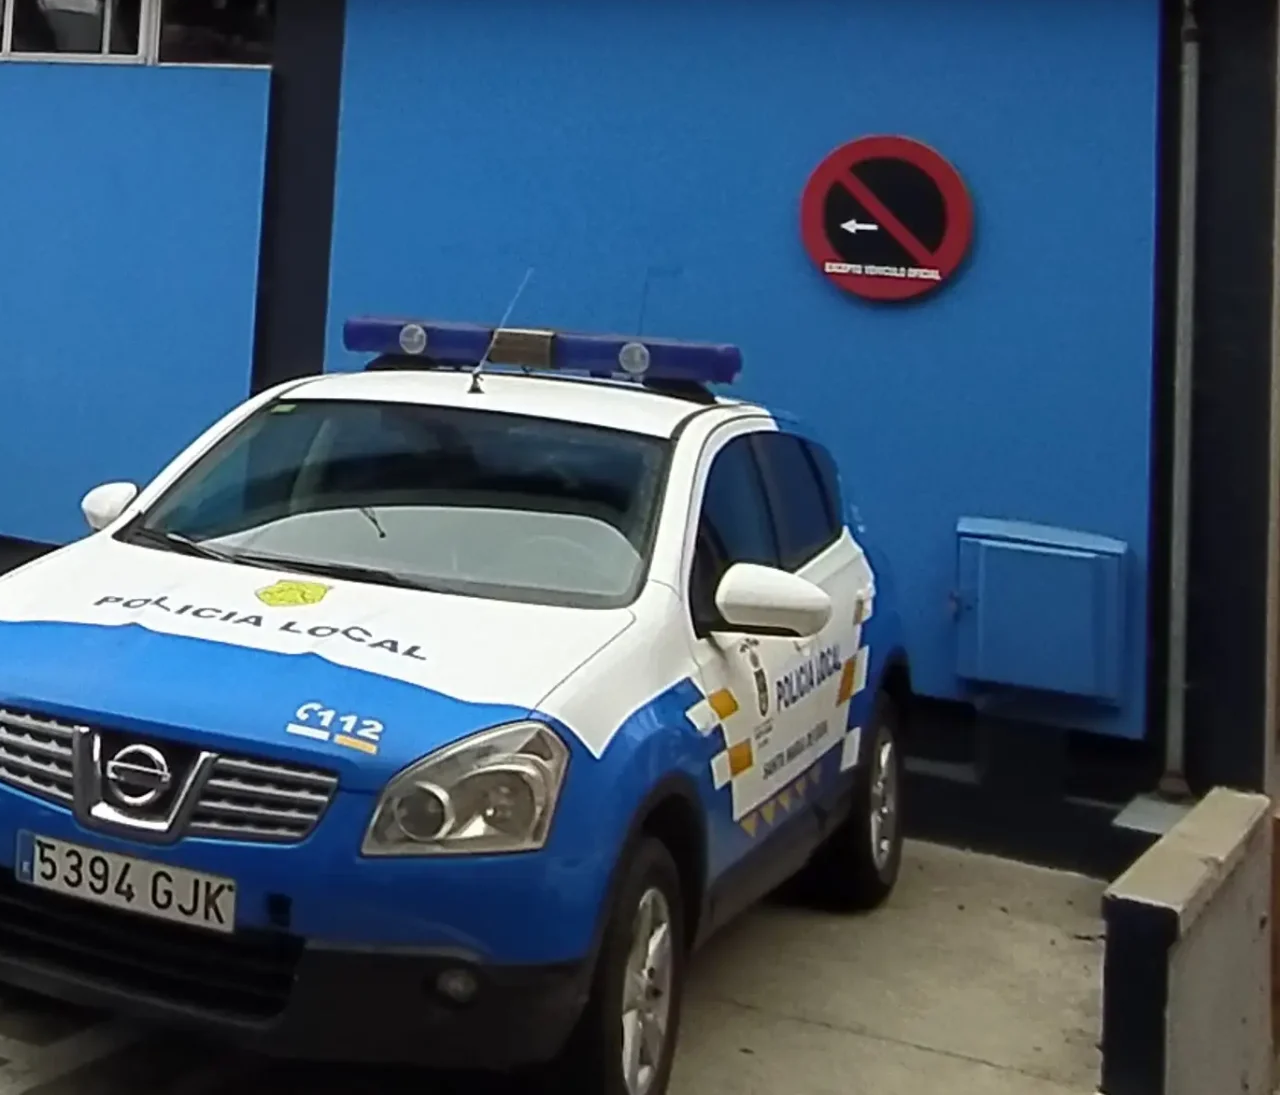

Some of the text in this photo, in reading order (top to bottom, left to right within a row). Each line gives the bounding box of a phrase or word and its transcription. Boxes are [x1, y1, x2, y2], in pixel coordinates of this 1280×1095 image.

[92, 594, 428, 661] POLICIA LOCAL
[317, 708, 384, 741] 112
[35, 838, 230, 925] 5394 GJK
